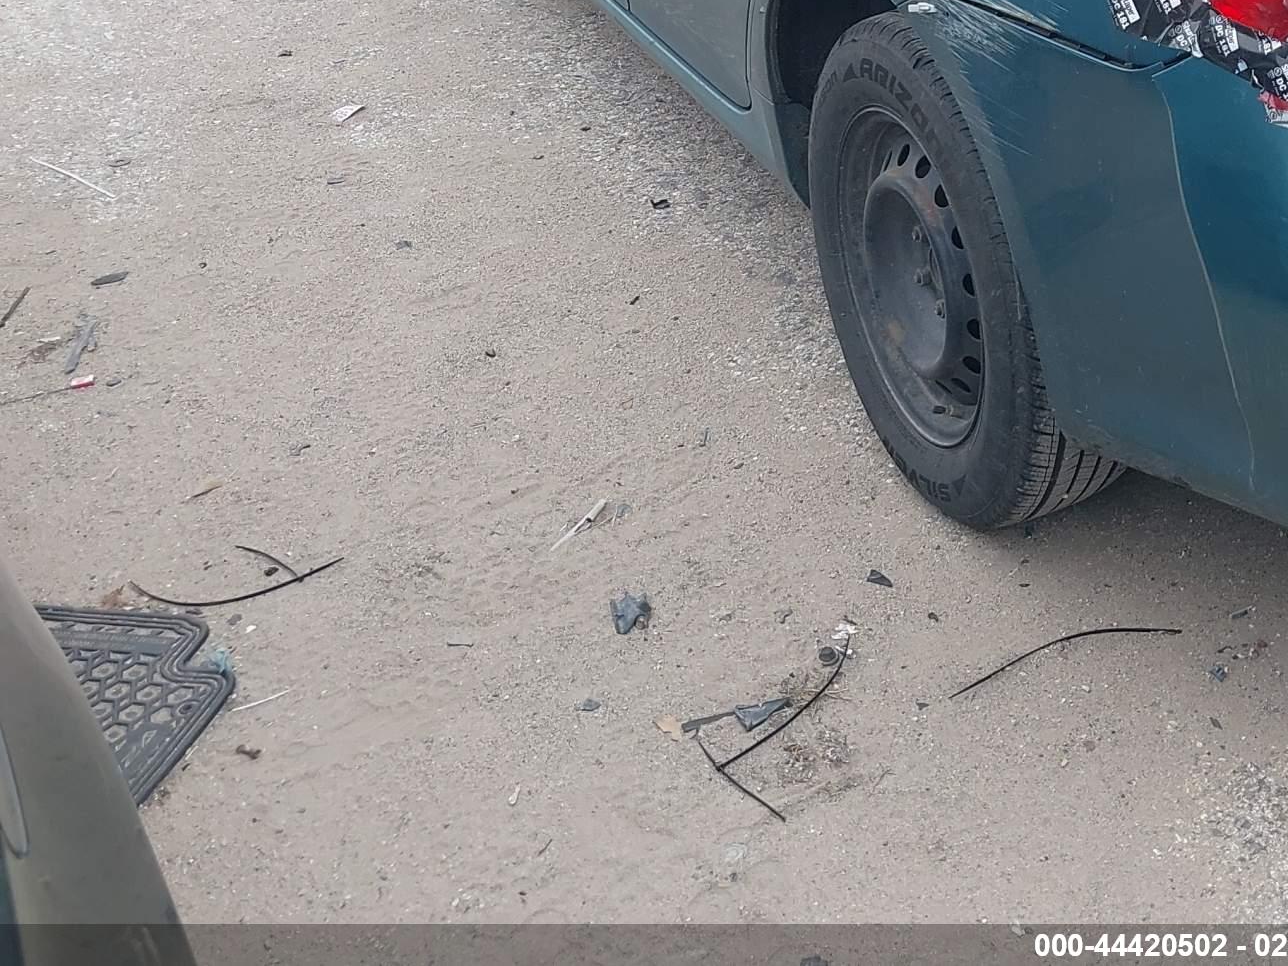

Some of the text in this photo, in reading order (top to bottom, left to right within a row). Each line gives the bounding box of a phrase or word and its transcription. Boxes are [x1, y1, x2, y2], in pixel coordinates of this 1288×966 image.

[1117, 11, 1130, 30] 181
[1215, 24, 1224, 38] DC
[1175, 34, 1188, 47] DC
[1276, 77, 1287, 91] DC
